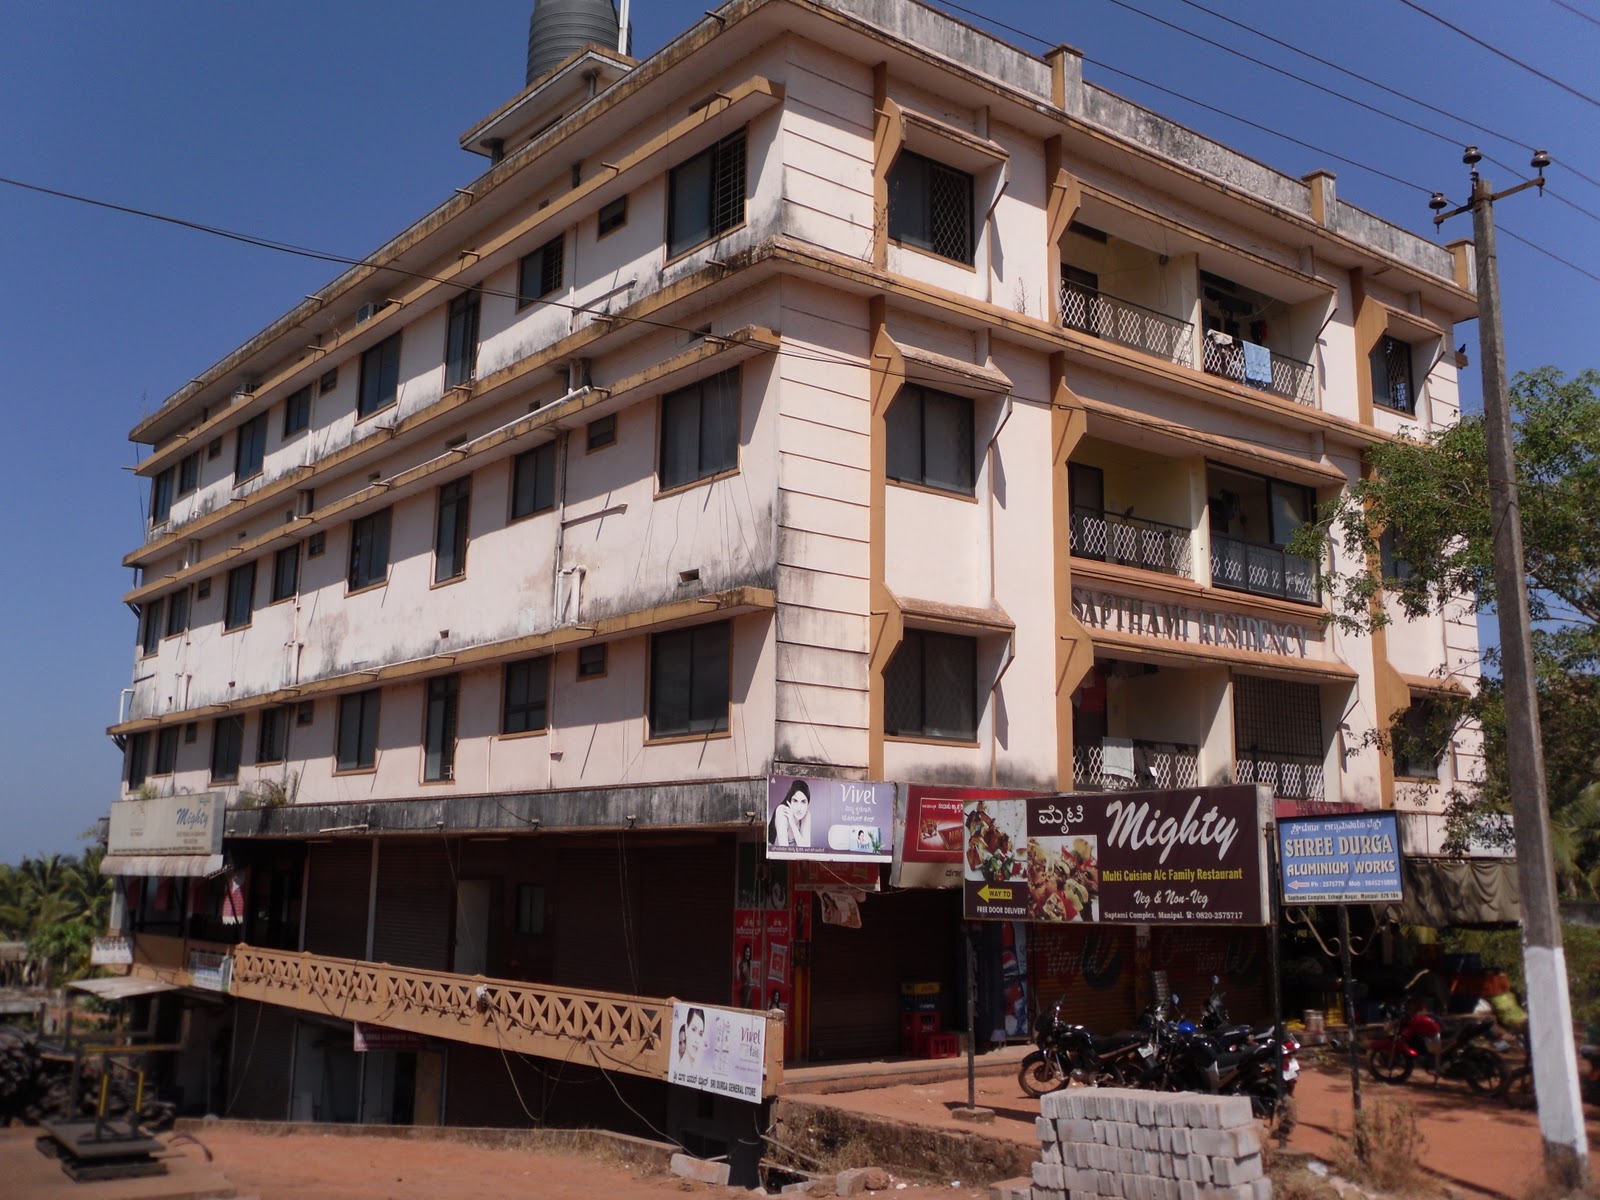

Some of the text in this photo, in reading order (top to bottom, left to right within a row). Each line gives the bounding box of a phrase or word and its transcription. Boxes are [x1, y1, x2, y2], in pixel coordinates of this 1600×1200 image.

[1072, 588, 1309, 658] SAPTHAMI RESIDENCY
[840, 784, 877, 805] Vivel
[176, 807, 209, 830] Mighty
[1038, 804, 1084, 834] ಮೈಟಿ
[1105, 795, 1239, 865] Mighty
[1285, 834, 1394, 858] SHREE DURGA
[1103, 868, 1243, 883] Multi Cuisine A/c Family Restaurant
[1286, 860, 1396, 877] ALUMINIUM WORKS
[989, 890, 1011, 898] WAY TO
[1133, 889, 1209, 908] Veg & Non-Veg
[989, 906, 1003, 914] DOOR
[1004, 906, 1026, 915] DELIVERY
[1104, 911, 1128, 920] Saptami
[741, 1027, 761, 1044] Vivel
[716, 1081, 728, 1091] DURGA
[728, 1083, 744, 1094] GENERAL
[744, 1086, 756, 1097] STORE
